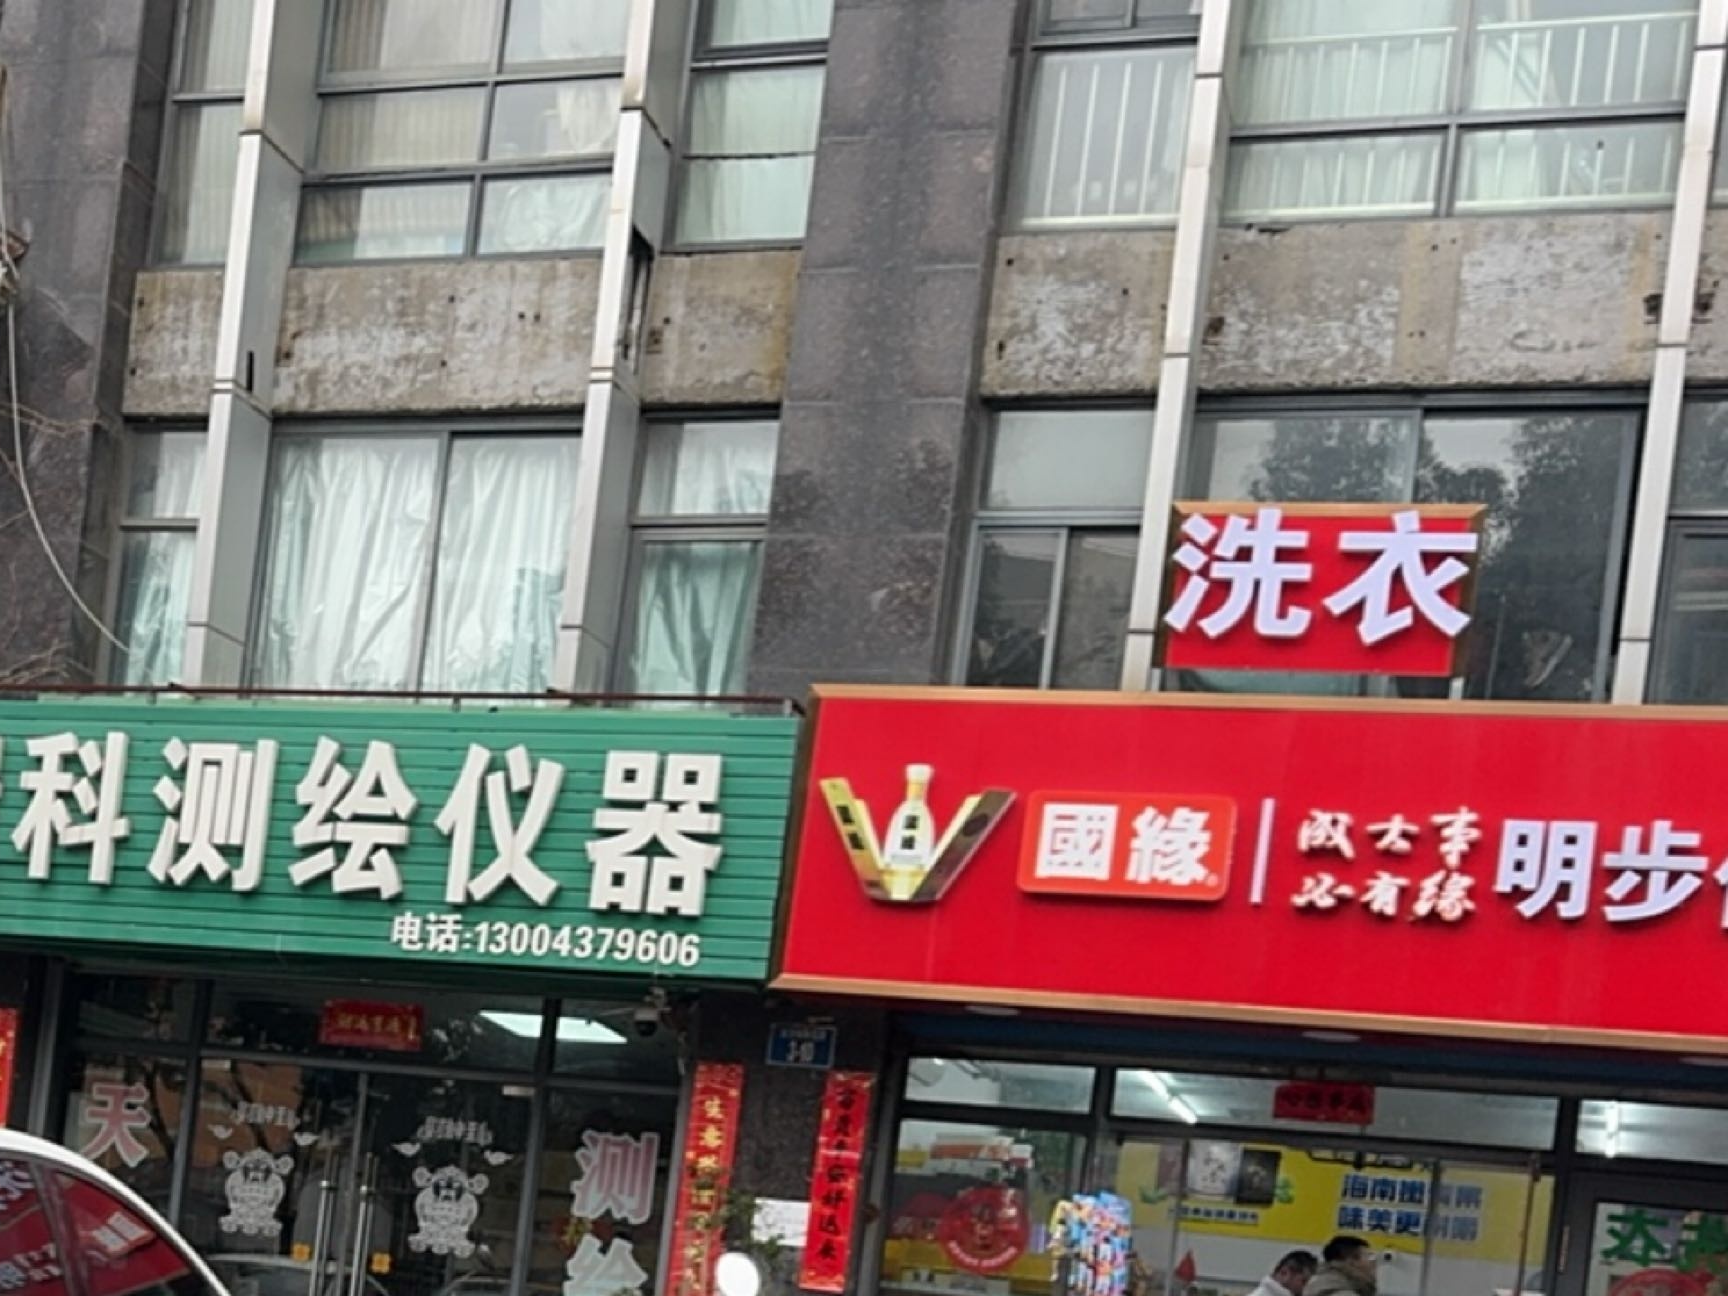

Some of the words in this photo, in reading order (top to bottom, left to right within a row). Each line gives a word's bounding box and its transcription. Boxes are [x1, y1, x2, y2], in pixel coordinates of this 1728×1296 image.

[1163, 507, 1478, 646] 洗衣
[1493, 818, 1728, 928] 明步
[82, 1083, 149, 1168] 天
